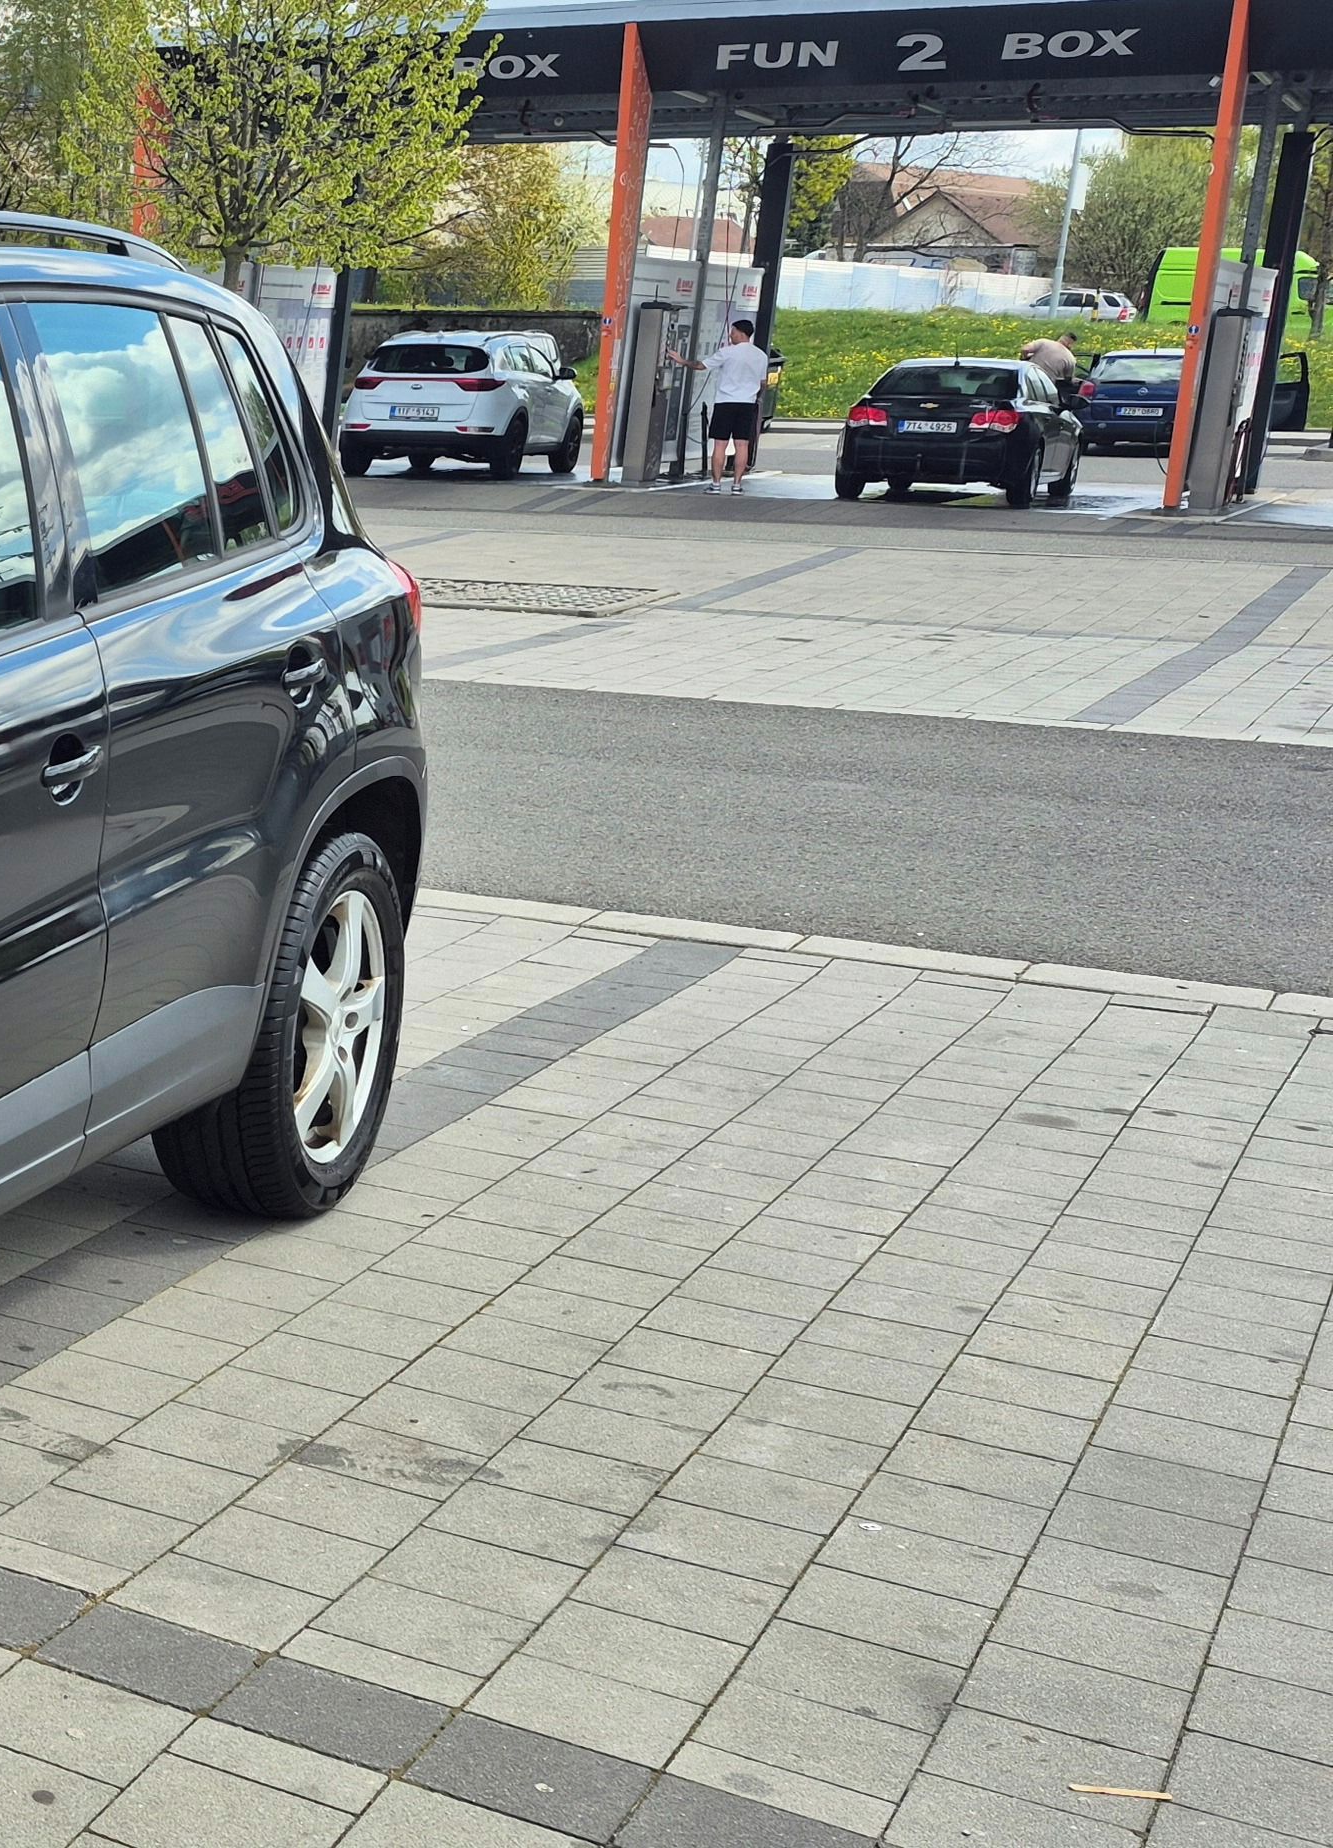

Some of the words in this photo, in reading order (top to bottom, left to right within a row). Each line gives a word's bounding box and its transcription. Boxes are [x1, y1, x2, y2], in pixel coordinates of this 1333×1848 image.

[715, 40, 839, 70] FUN
[895, 33, 947, 72] 2
[1000, 28, 1142, 61] BOX
[453, 53, 561, 80] BOX
[906, 421, 923, 430] 7T4
[930, 422, 952, 431] 4925
